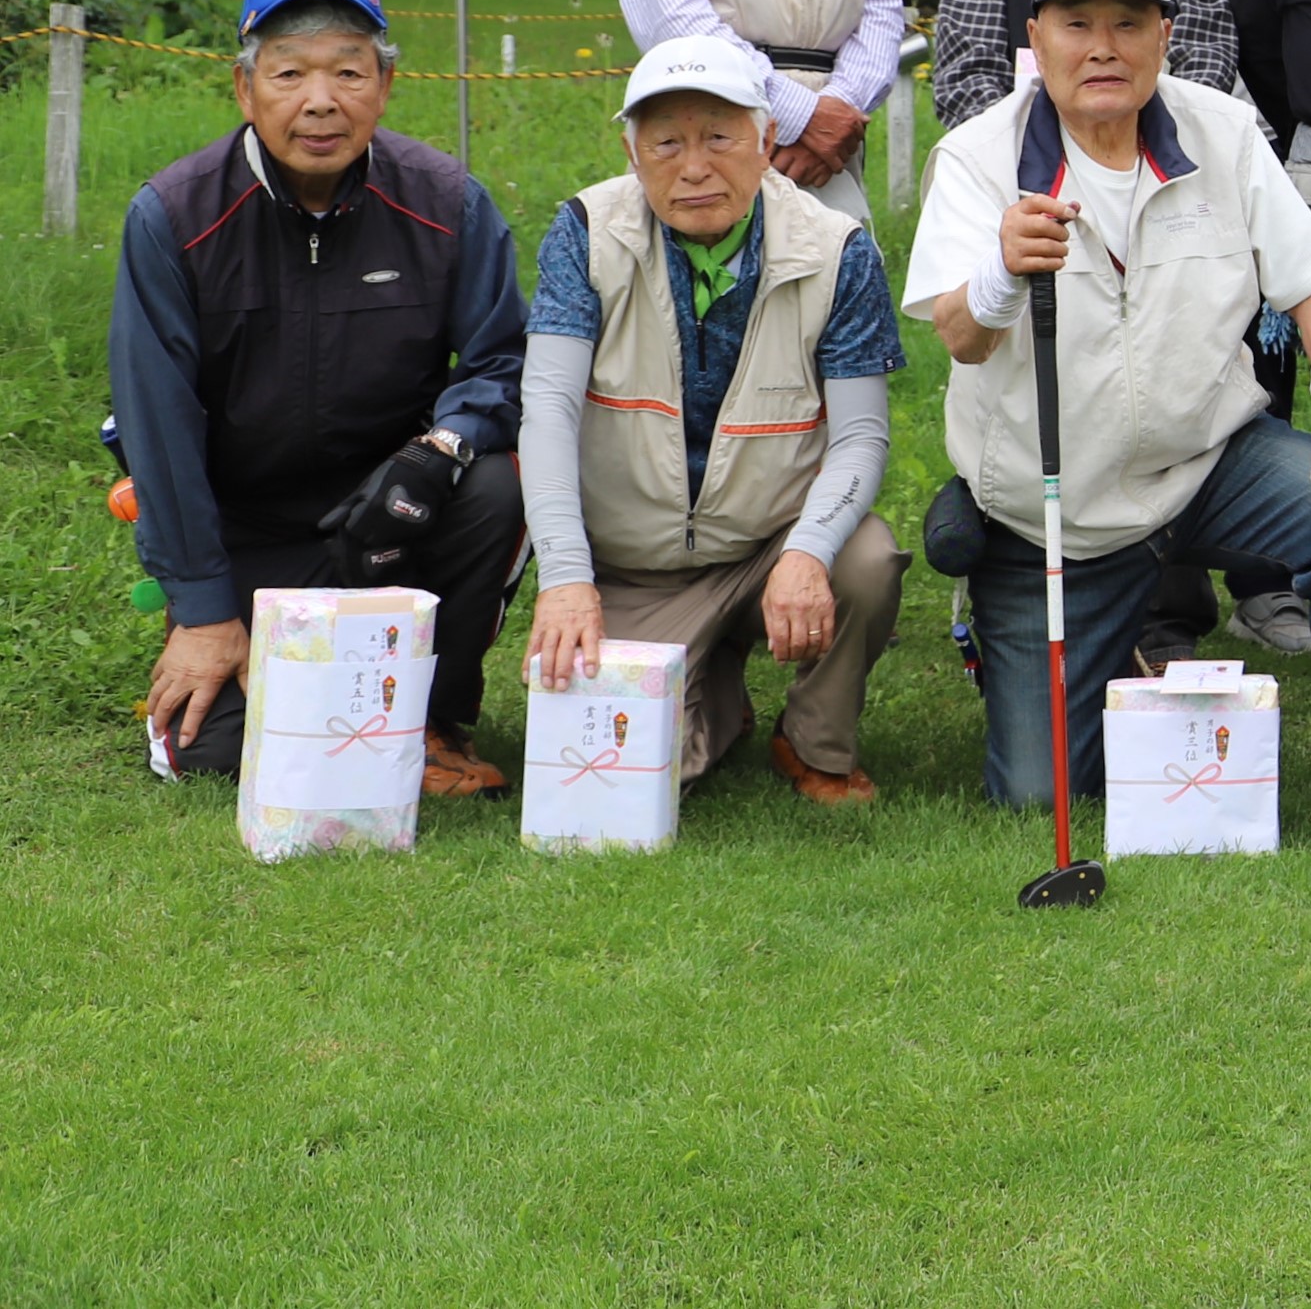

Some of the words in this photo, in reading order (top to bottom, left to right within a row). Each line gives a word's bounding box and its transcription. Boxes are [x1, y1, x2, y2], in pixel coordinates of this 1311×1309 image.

[665, 59, 707, 76] XXIO
[350, 671, 365, 714] 賞五位
[581, 706, 596, 746] 賞四位
[1184, 721, 1199, 762] 賞三位
